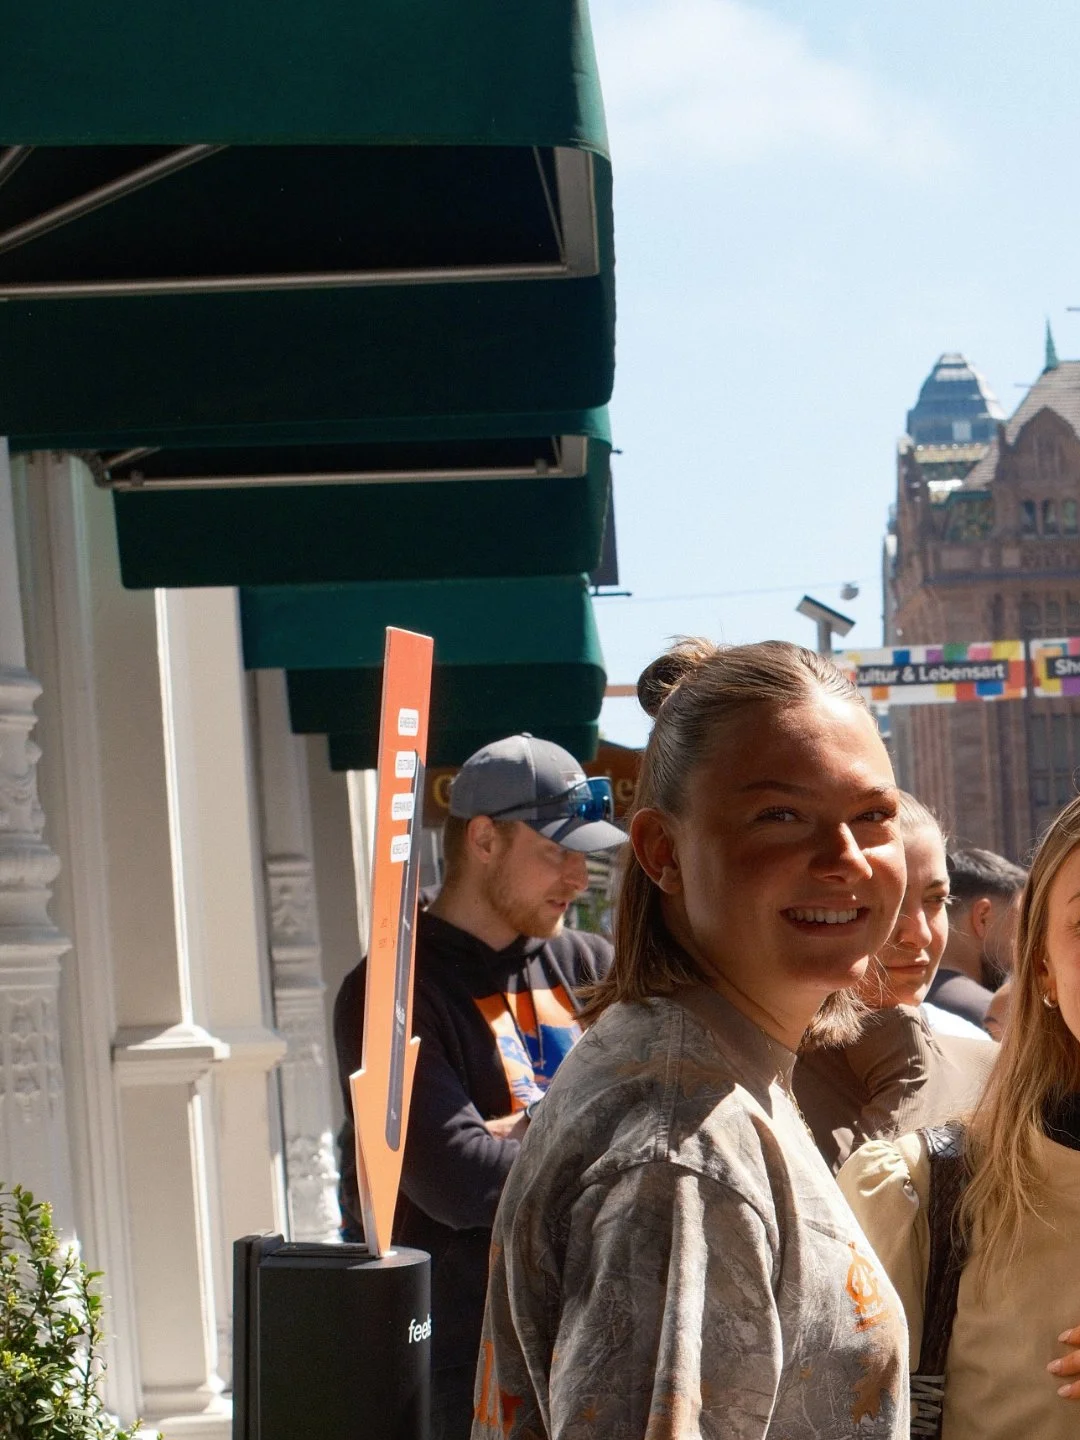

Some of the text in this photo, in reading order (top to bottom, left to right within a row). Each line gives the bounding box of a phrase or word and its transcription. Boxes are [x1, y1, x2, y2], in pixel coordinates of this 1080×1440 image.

[858, 663, 1005, 684] ultur & Lebensart
